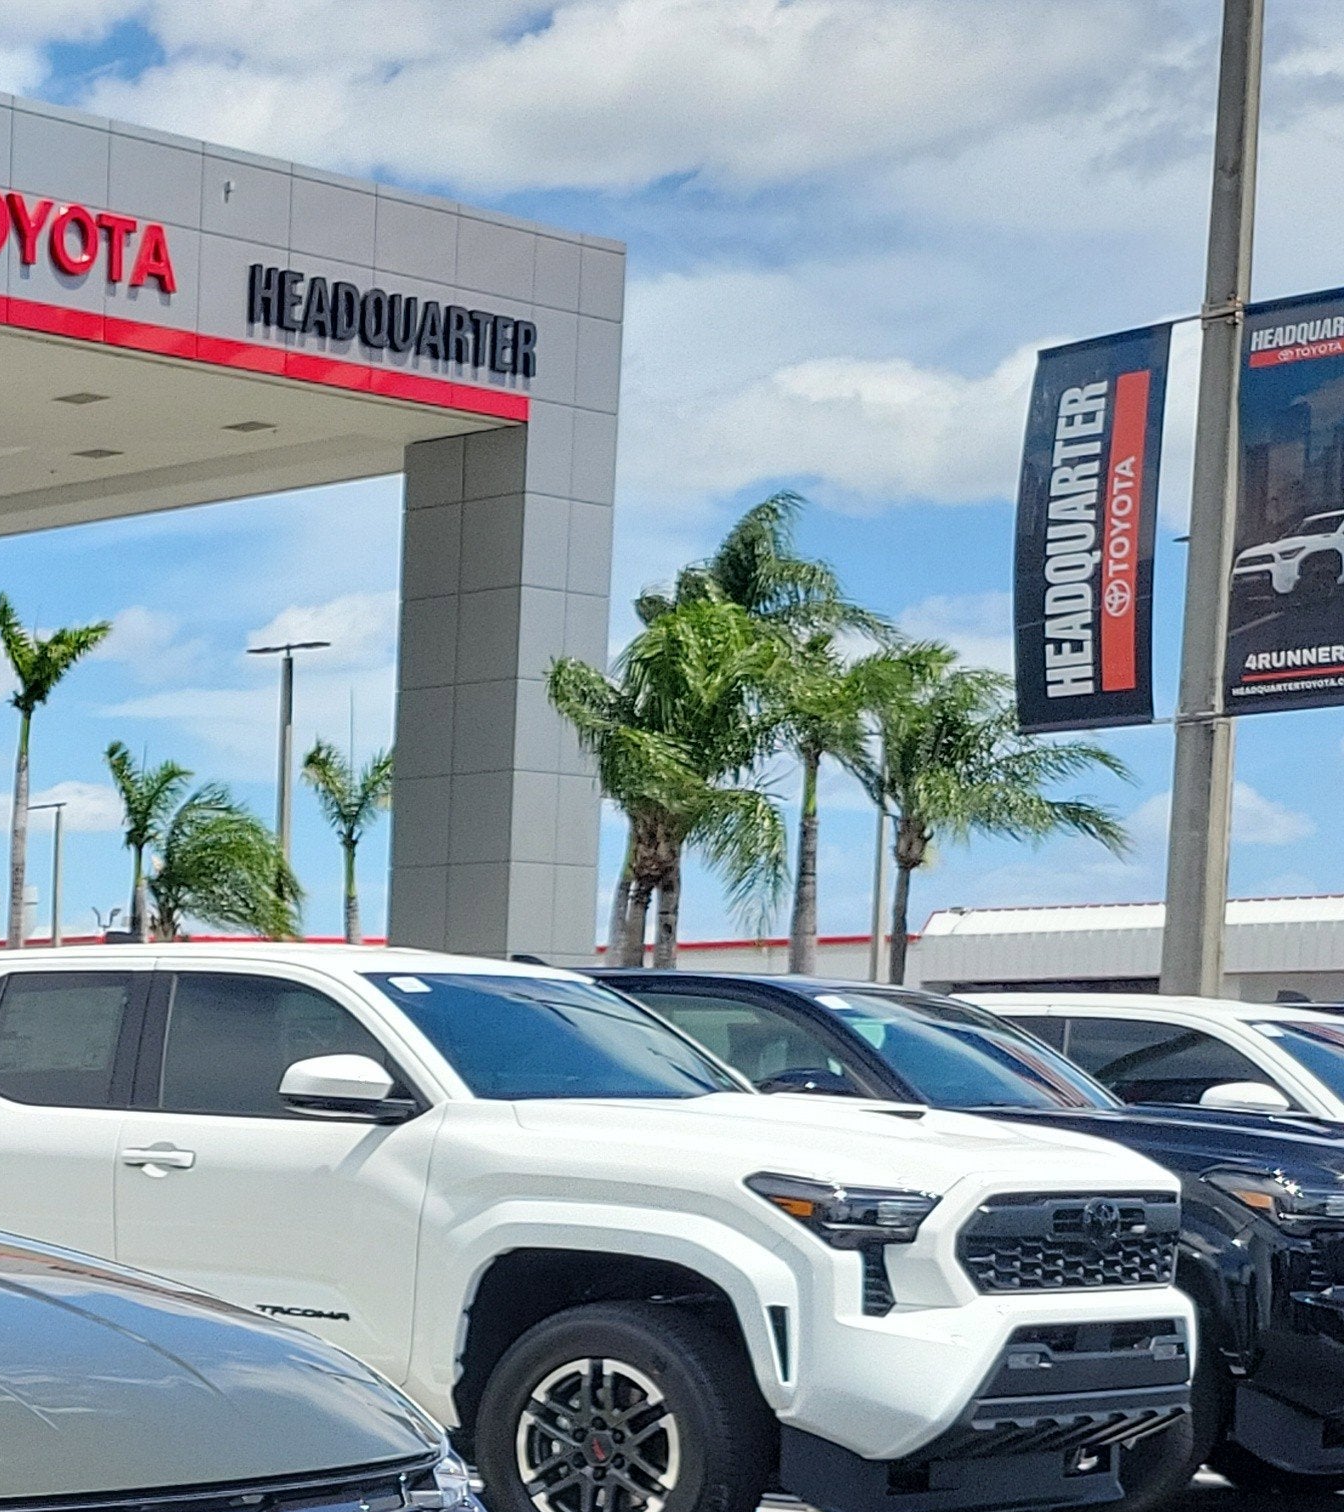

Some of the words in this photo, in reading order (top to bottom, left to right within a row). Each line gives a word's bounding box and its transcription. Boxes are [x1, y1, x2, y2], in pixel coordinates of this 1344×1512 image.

[248, 263, 537, 377] HEADQUARTER
[1251, 316, 1344, 352] HEADQUAR
[1295, 341, 1343, 358] TOYOTA
[1044, 380, 1108, 698] HEADQUARTER
[1105, 456, 1136, 577] TOYOTA
[1244, 645, 1344, 670] 4RUNNER
